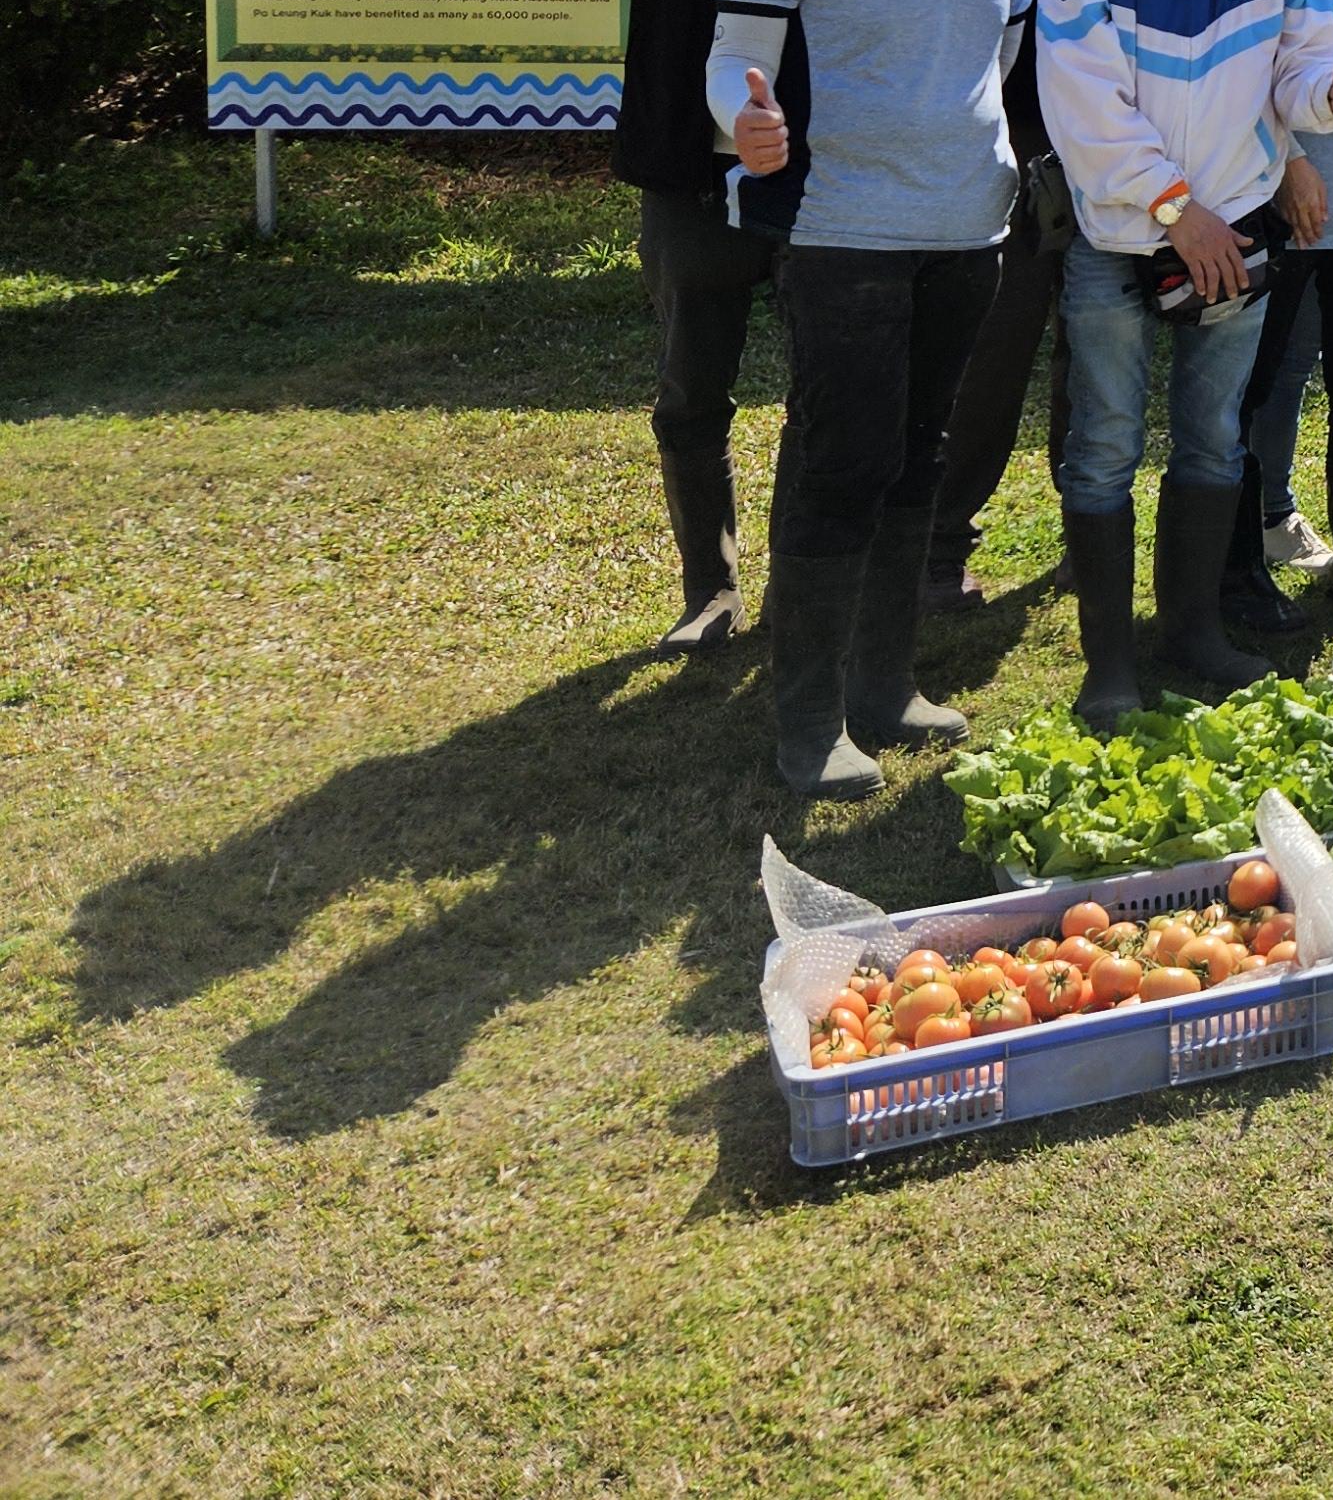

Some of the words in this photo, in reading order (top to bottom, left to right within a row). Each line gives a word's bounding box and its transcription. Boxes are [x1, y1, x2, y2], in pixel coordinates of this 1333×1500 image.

[271, 9, 307, 18] Leung
[310, 9, 331, 17] Kuk
[334, 9, 362, 18] have
[364, 8, 419, 18] benefited
[437, 11, 468, 20] many
[486, 7, 529, 21] 60,000
